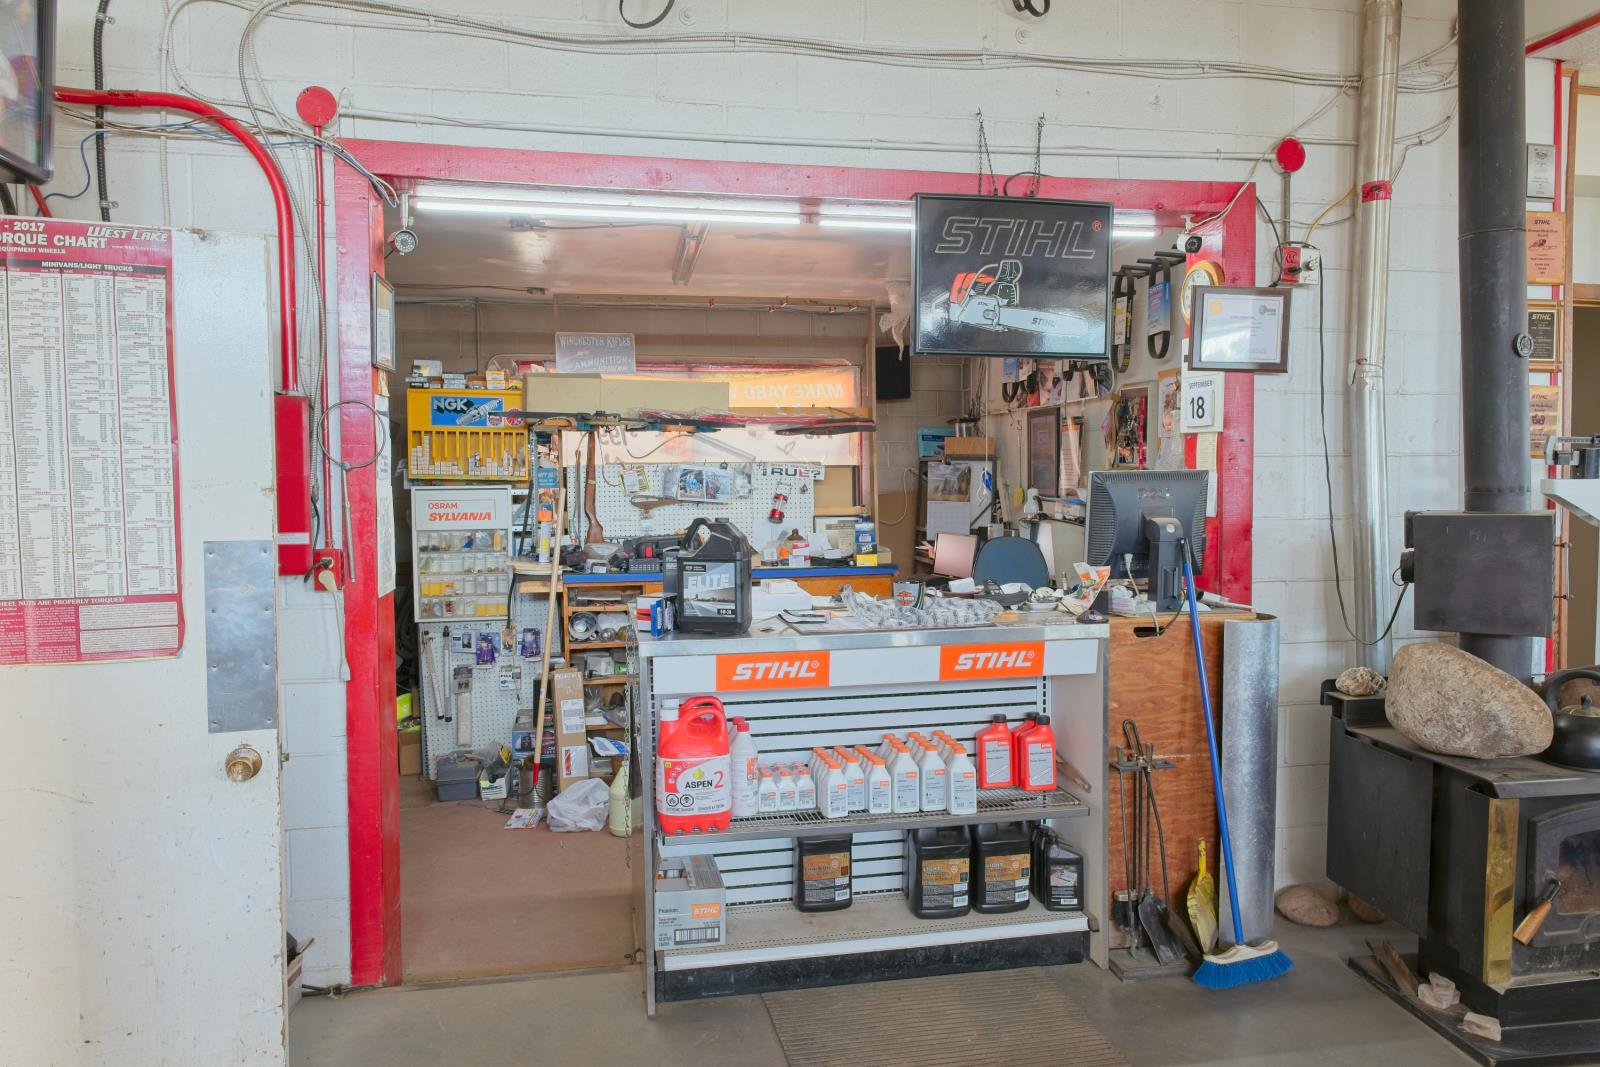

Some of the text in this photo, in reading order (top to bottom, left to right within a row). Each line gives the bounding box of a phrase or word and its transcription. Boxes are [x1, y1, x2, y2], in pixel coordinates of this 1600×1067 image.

[13, 221, 46, 232] 2017
[0, 232, 48, 246] RQUE
[53, 234, 108, 249] CHART
[934, 216, 1096, 260] STIHL
[41, 261, 134, 272] MINIVANS/LIGHT TRUCKS
[1189, 379, 1213, 390] SEPTEMBER
[432, 397, 469, 411] NGK
[1189, 396, 1205, 420] 18
[428, 502, 458, 510] OSRAM
[428, 511, 492, 522] SYLVANIA
[687, 574, 730, 590] ELITE
[954, 650, 1027, 671] STIHL
[732, 660, 811, 681] STIHL
[685, 770, 725, 789] ASPEN 2
